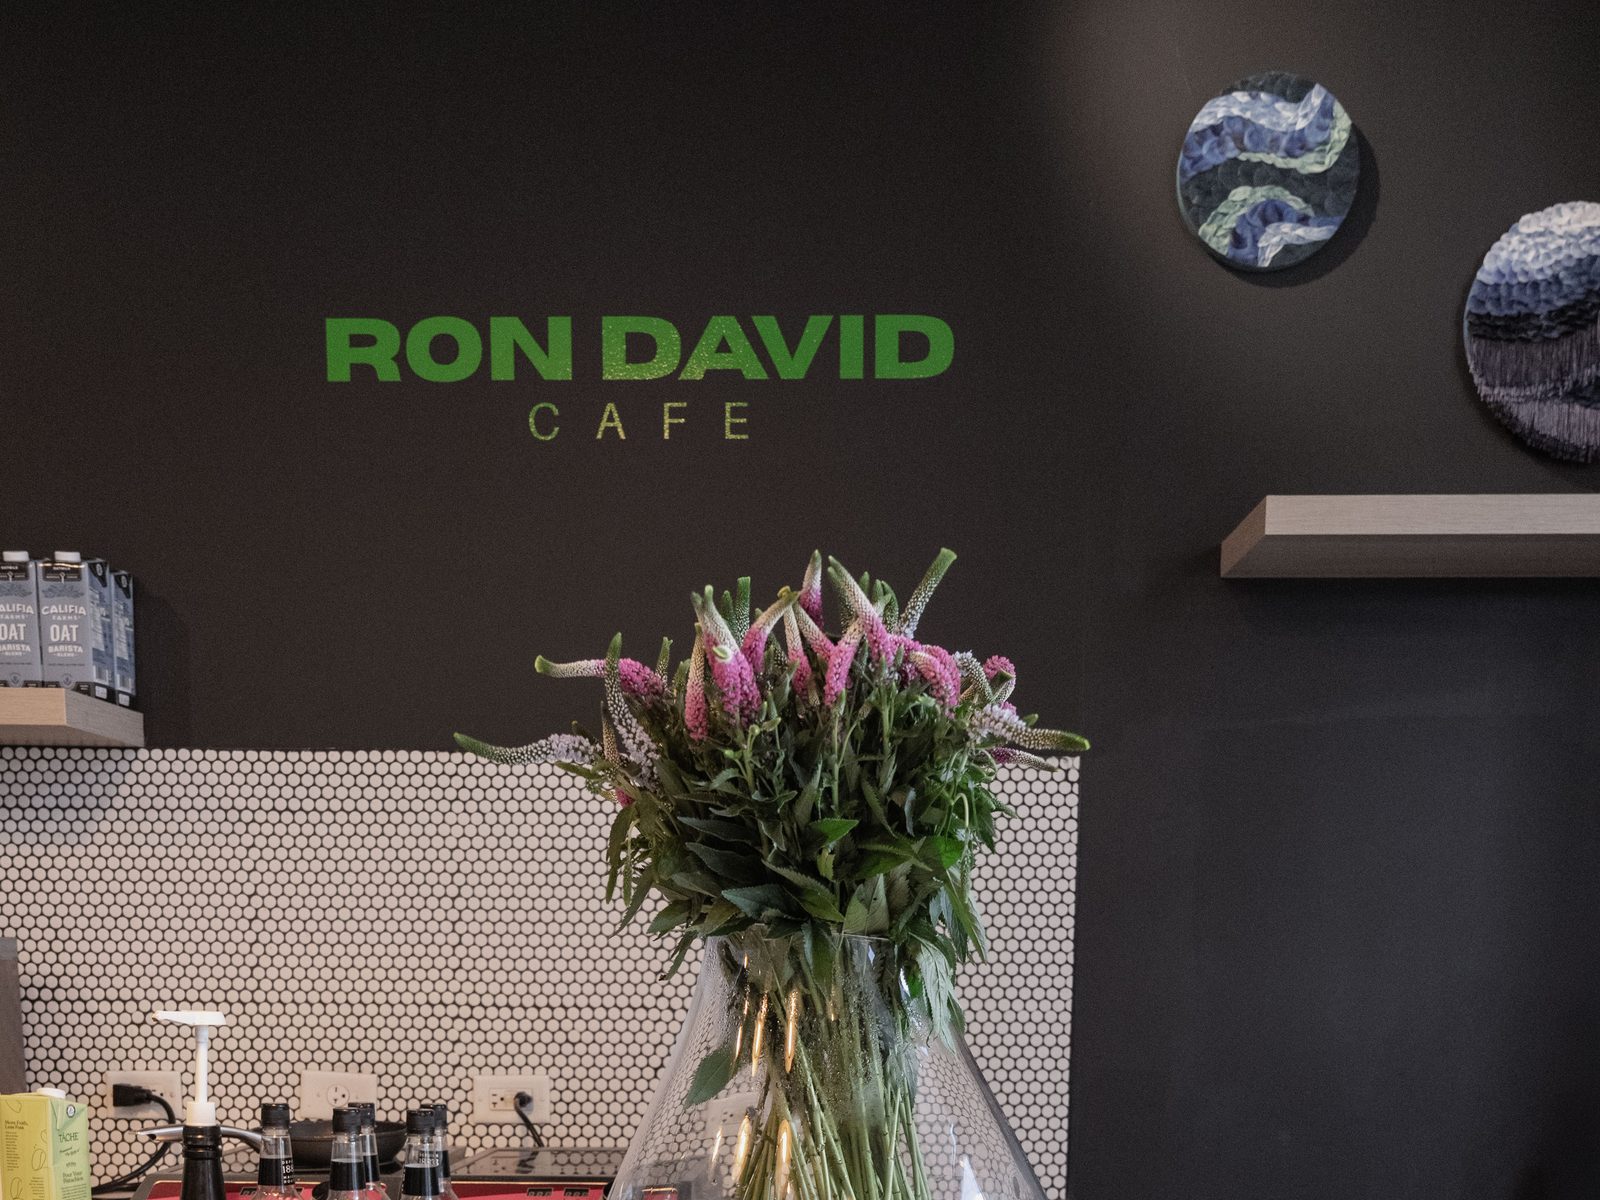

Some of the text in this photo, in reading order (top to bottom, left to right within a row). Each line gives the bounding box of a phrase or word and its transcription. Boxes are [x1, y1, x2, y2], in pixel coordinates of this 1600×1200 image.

[325, 313, 955, 383] RON DAVID
[528, 401, 750, 441] CAFE
[41, 604, 87, 615] CALIFIA
[50, 624, 79, 642] OAT
[48, 644, 84, 653] BARISTA
